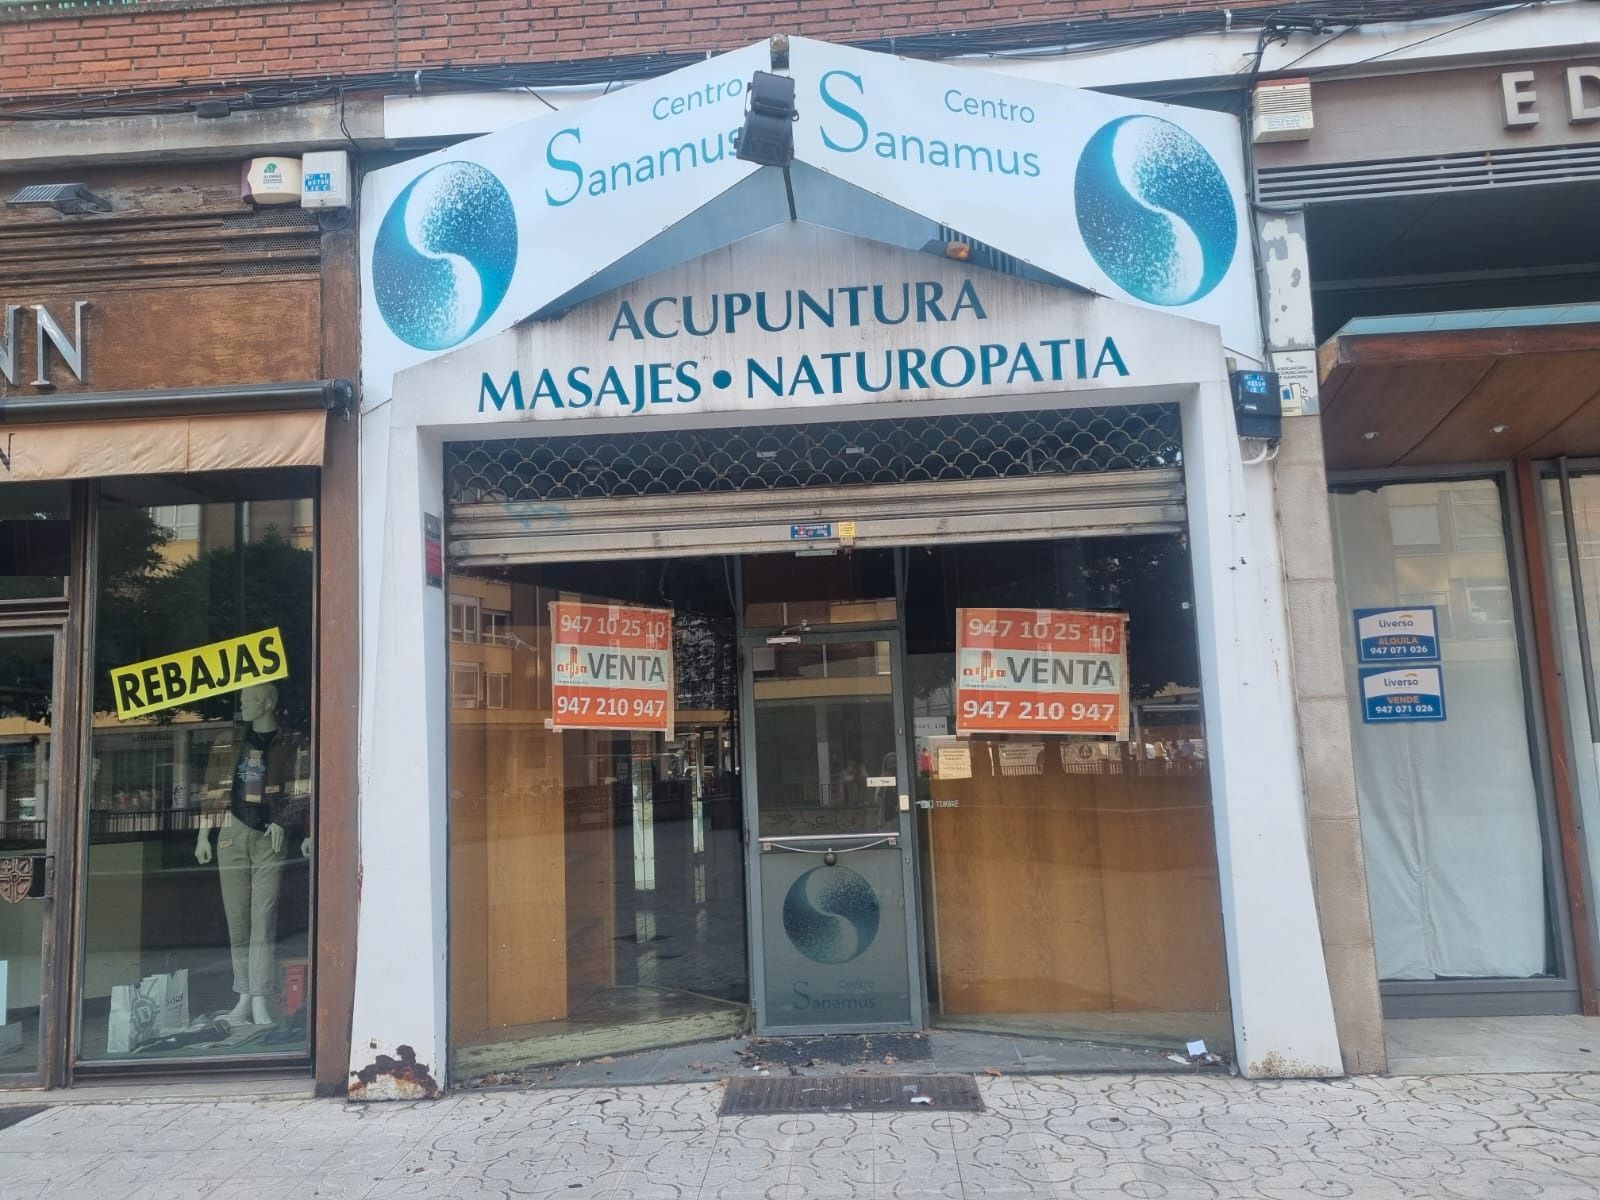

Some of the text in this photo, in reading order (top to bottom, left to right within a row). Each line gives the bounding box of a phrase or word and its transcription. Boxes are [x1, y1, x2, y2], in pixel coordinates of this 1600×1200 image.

[652, 78, 742, 120] Centro
[944, 89, 1035, 124] Centro
[819, 70, 1041, 178] Sanamus
[608, 278, 987, 342] ACUPUNTURA
[478, 336, 1129, 414] MASAJES NATUROPATIA
[560, 614, 665, 639] 947 10 25 10
[968, 618, 1115, 642] 947 10 25 10
[1379, 619, 1414, 628] Liverso
[1370, 645, 1428, 655] 947 071 026
[1378, 636, 1418, 645] ALQUILA
[117, 636, 281, 712] REBAJAS
[588, 653, 665, 682] VENTA
[1006, 656, 1115, 686] VENTA
[1384, 678, 1419, 687] Liverso
[557, 696, 665, 717] 947 210 947
[963, 700, 1115, 721] 947 210 947
[1375, 704, 1433, 714] 947 071 026
[1387, 695, 1420, 704] VENDE
[793, 980, 877, 1010] Sanamus
